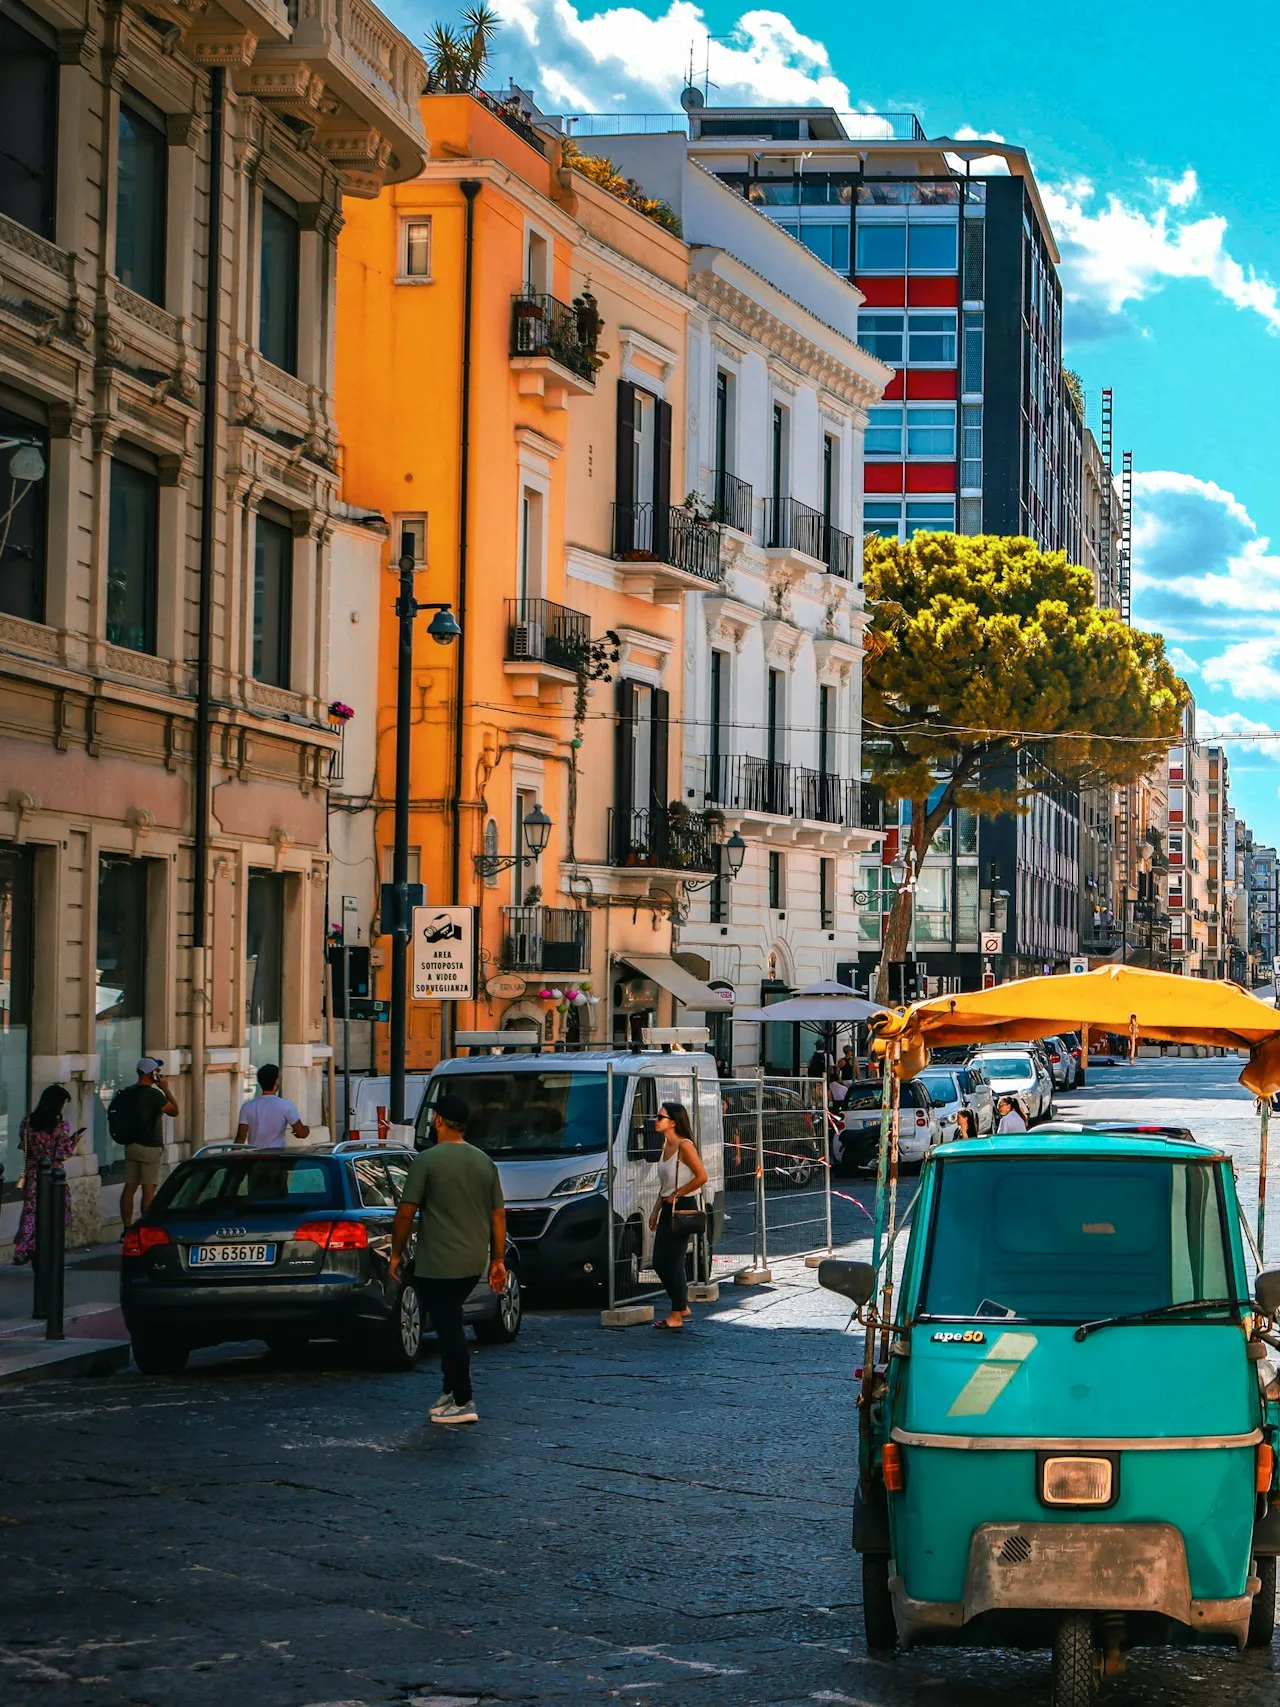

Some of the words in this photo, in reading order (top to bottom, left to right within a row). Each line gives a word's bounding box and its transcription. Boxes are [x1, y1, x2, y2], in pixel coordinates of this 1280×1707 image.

[416, 984, 469, 992] SORVEGLIANZA
[199, 1247, 217, 1261] DS
[221, 1246, 265, 1261] 636YB
